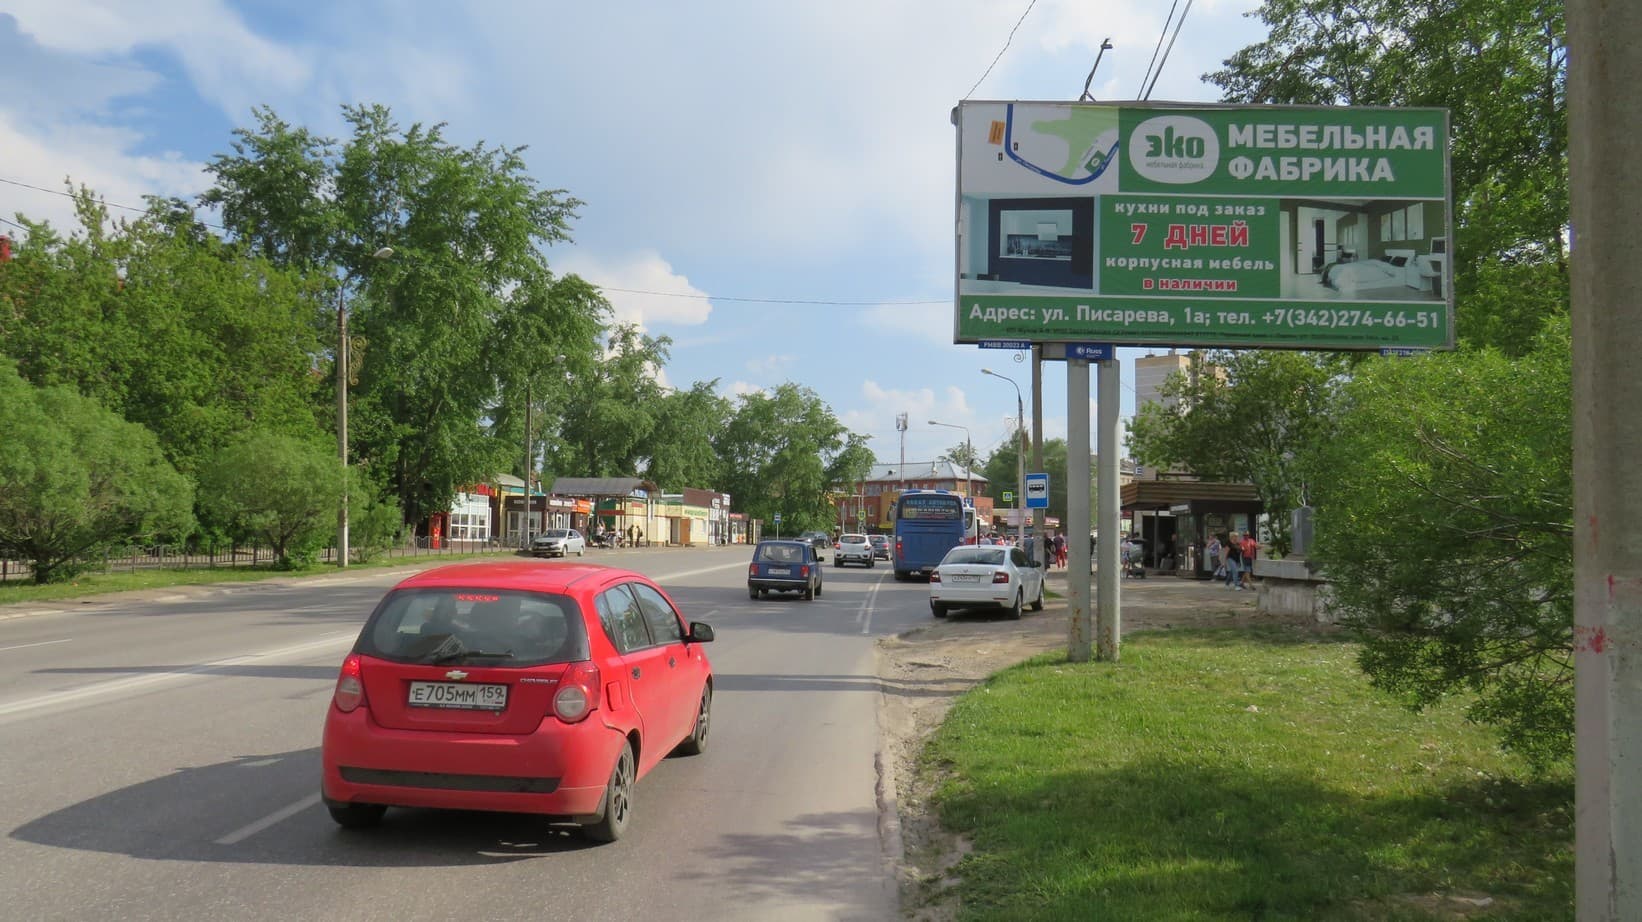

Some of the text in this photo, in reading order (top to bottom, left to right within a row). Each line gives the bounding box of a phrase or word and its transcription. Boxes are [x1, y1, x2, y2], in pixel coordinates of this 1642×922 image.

[1228, 124, 1434, 150] МЕБЕЛЬНАЯ
[1228, 156, 1395, 182] ФАБРИКА
[1114, 202, 1265, 217] кухни под заказ
[1131, 220, 1249, 250] 7 ДНЕЙ
[1106, 257, 1274, 271] корпусная мебель
[1143, 278, 1238, 292] в наличии
[969, 303, 1438, 328] Адрес: ул. Писарева, 1а; тел. +7(342)274-66-51
[414, 685, 475, 702] Е705ММ
[479, 687, 505, 699] 159
